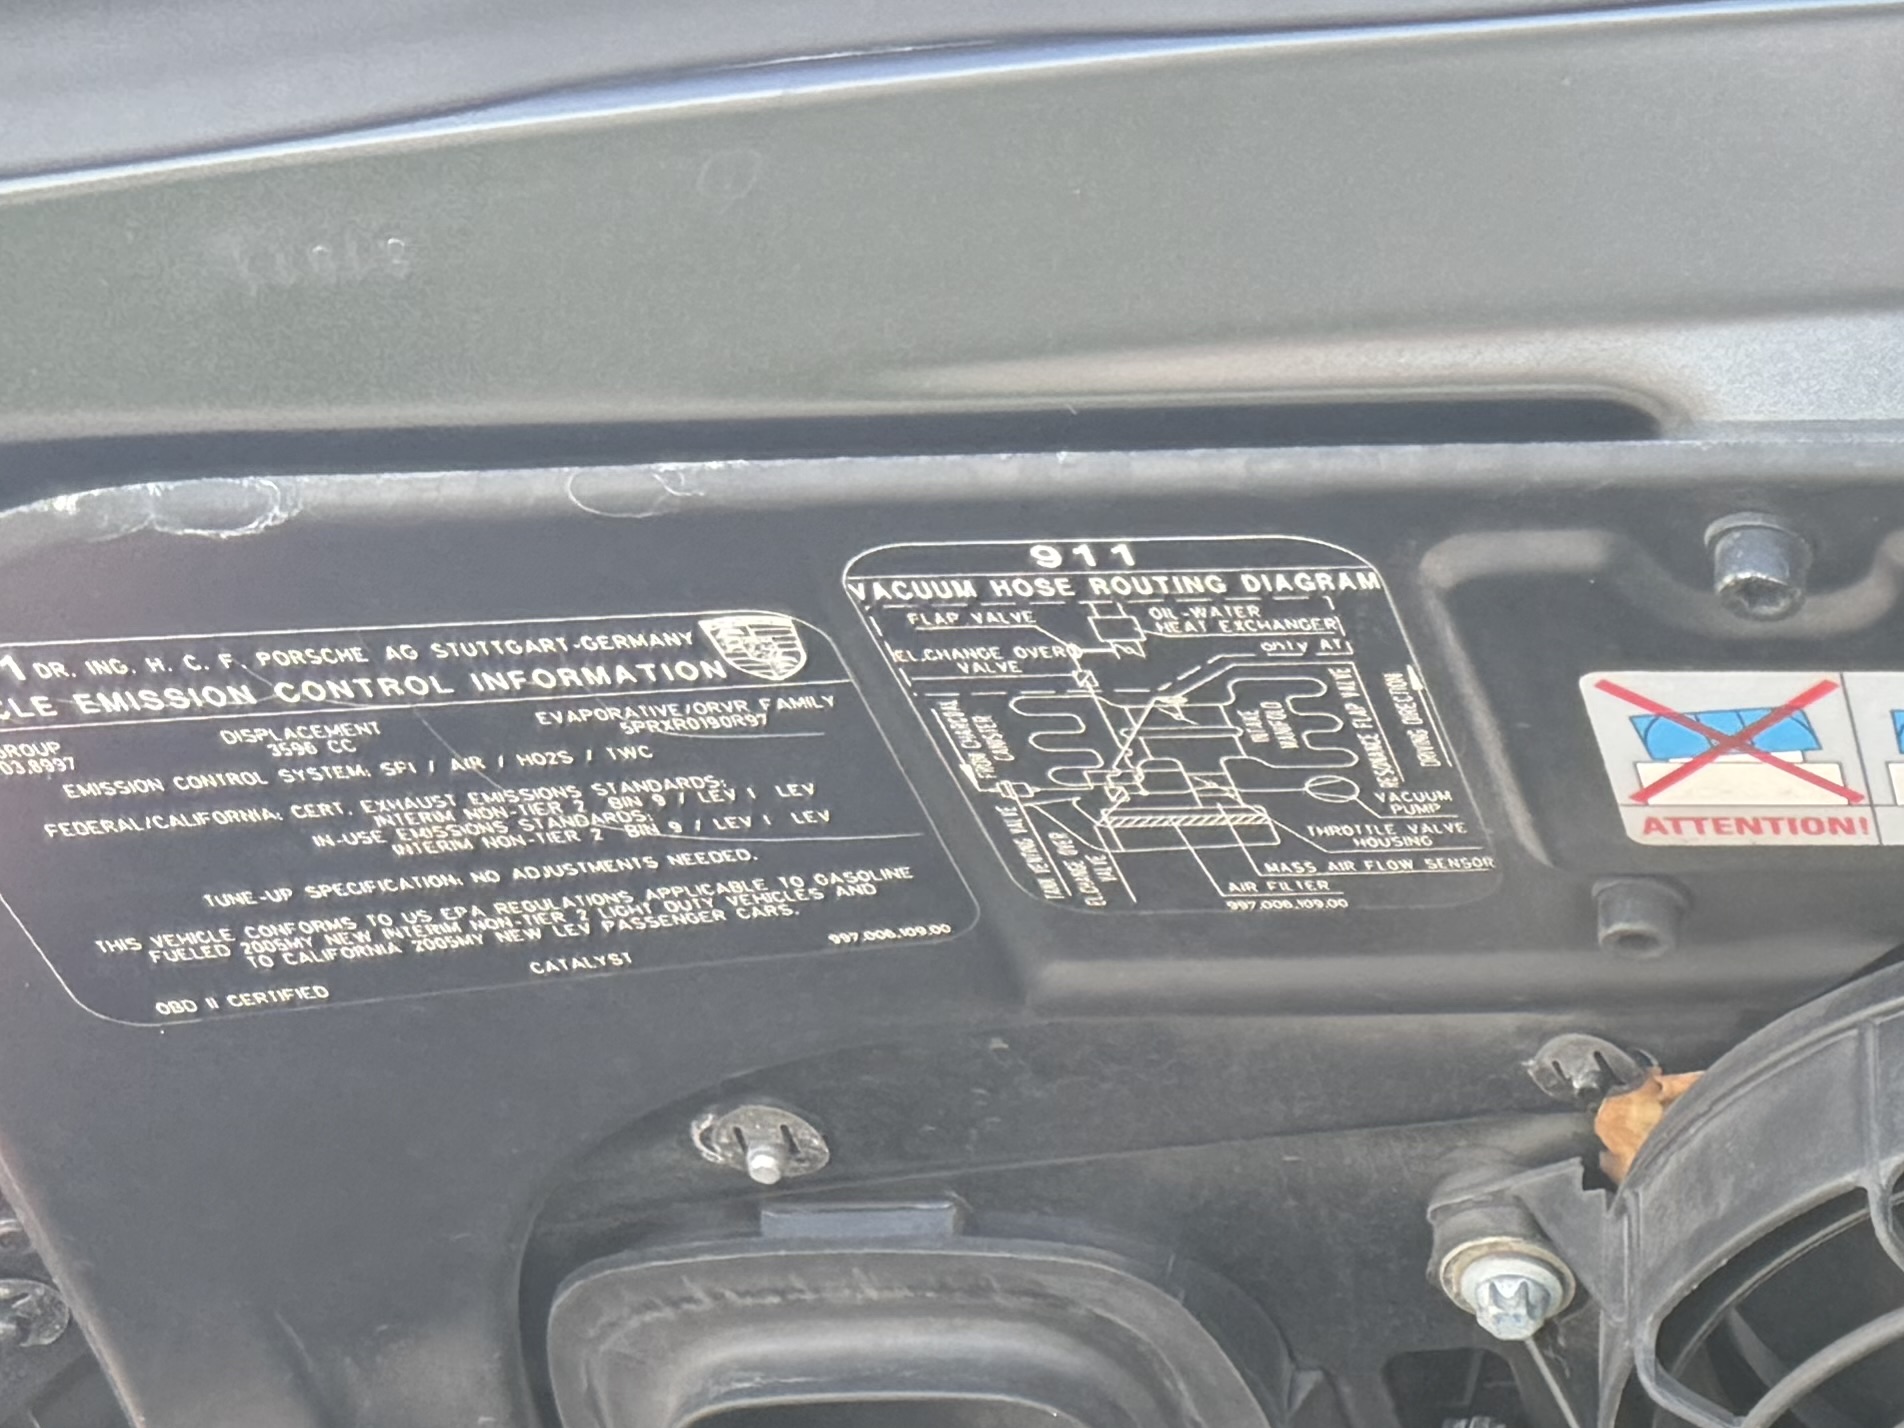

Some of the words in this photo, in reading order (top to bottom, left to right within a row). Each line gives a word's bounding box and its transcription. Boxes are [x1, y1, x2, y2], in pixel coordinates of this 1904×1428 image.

[848, 577, 977, 601] VACUUM
[990, 576, 1076, 597] HOSE
[1088, 574, 1227, 596] ROUTING
[1240, 571, 1381, 594] DIAGRAM
[907, 612, 958, 626] FLAP
[971, 610, 1037, 625] VALVE
[1148, 605, 1261, 620] OIL-WATER
[1154, 620, 1206, 634] HEAT
[1222, 618, 1337, 633] EXCHANGER
[32, 661, 77, 679] DR.
[84, 657, 137, 675] ING.
[145, 656, 173, 673] H.
[183, 655, 209, 671] C.
[256, 647, 369, 667] PORSCHE
[385, 644, 418, 661] AG
[957, 661, 1023, 674] VALVE
[73, 683, 258, 714] EMISSION
[273, 675, 455, 702] CONTROL
[471, 660, 728, 693] INFORMATION
[759, 695, 837, 711] FAMILY
[219, 721, 382, 745] DISPLACEMENT
[327, 739, 358, 754] CC
[61, 777, 164, 800] EMISSION
[172, 771, 270, 792] CONTROL
[380, 761, 417, 777] SFI
[449, 756, 486, 772] AIR
[605, 745, 655, 761] TWC
[290, 802, 352, 821] CERT.
[360, 793, 457, 815] EXHAUST
[467, 785, 583, 806] EMISSIONS
[373, 809, 457, 829] INTERIM
[463, 801, 565, 821] NON-TIER
[608, 795, 644, 810] BIN
[697, 788, 738, 804] LEV
[775, 782, 816, 798] LEV
[1374, 790, 1453, 804] VACUUM
[1390, 803, 1441, 816] PUMP
[312, 831, 388, 849] IN-USE
[398, 820, 507, 843] EMISSIONS
[392, 838, 474, 857] INTERIM
[484, 830, 579, 851] NON-TIER
[713, 814, 752, 831] LEV
[791, 810, 831, 825] LEV
[1306, 823, 1396, 837] THROTTLE
[1406, 822, 1467, 835] VALVE
[1641, 816, 1871, 837] ATTENTION!
[1353, 836, 1433, 849] HOUSING
[1263, 861, 1318, 874] MASS
[1327, 860, 1357, 872] AIR
[1364, 858, 1414, 872] FLOW
[1424, 856, 1495, 870] SENSOR
[203, 888, 293, 909] TUNE-UP
[472, 869, 501, 885] NO
[512, 856, 659, 881] ADJUSTMENTS
[666, 849, 759, 867] NEEDED.
[1227, 880, 1258, 893] AIR
[1266, 879, 1330, 892] FILTER
[95, 937, 143, 955] THIS
[149, 928, 237, 949] VEHICLE
[243, 917, 358, 940] CONFORMS
[366, 914, 392, 929] TO
[402, 910, 433, 926] US
[439, 905, 486, 922] EPA
[494, 891, 634, 917] REGULATIONS
[645, 878, 767, 901] APPLICABLE
[778, 875, 806, 891] TO
[814, 866, 914, 886] GASOLINE
[148, 944, 232, 964] FUELED
[323, 930, 373, 947] NEW
[382, 920, 462, 942] INTERIM
[468, 910, 576, 933] NON-TIER
[599, 902, 652, 920] LIGHT
[663, 896, 716, 913] DUTY
[724, 887, 825, 908] VEHICLES
[835, 882, 878, 898] AND
[246, 955, 274, 970] TO
[283, 943, 403, 968] CALIFORNIA
[497, 927, 543, 944] NEW
[553, 922, 591, 938] LEV
[601, 908, 728, 933] PASSENGER
[736, 903, 800, 920] CARS.
[529, 952, 634, 975] CATALYST
[155, 999, 199, 1016] OBD
[227, 985, 330, 1008] CERTIFIED
